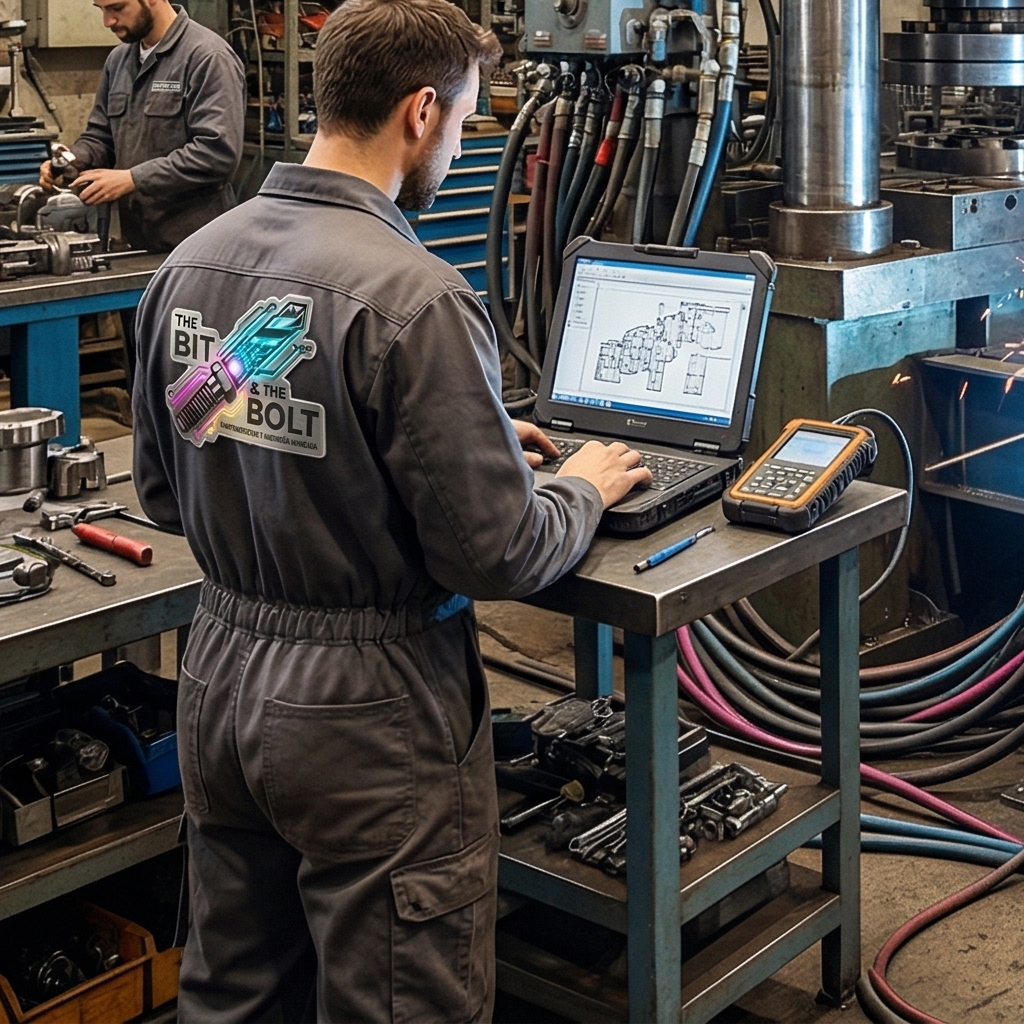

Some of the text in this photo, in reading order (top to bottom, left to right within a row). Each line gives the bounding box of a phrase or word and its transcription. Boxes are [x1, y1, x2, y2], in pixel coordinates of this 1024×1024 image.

[175, 314, 198, 329] THE
[174, 330, 215, 363] BIT
[250, 382, 286, 399] & THE
[247, 397, 320, 438] BOLT
